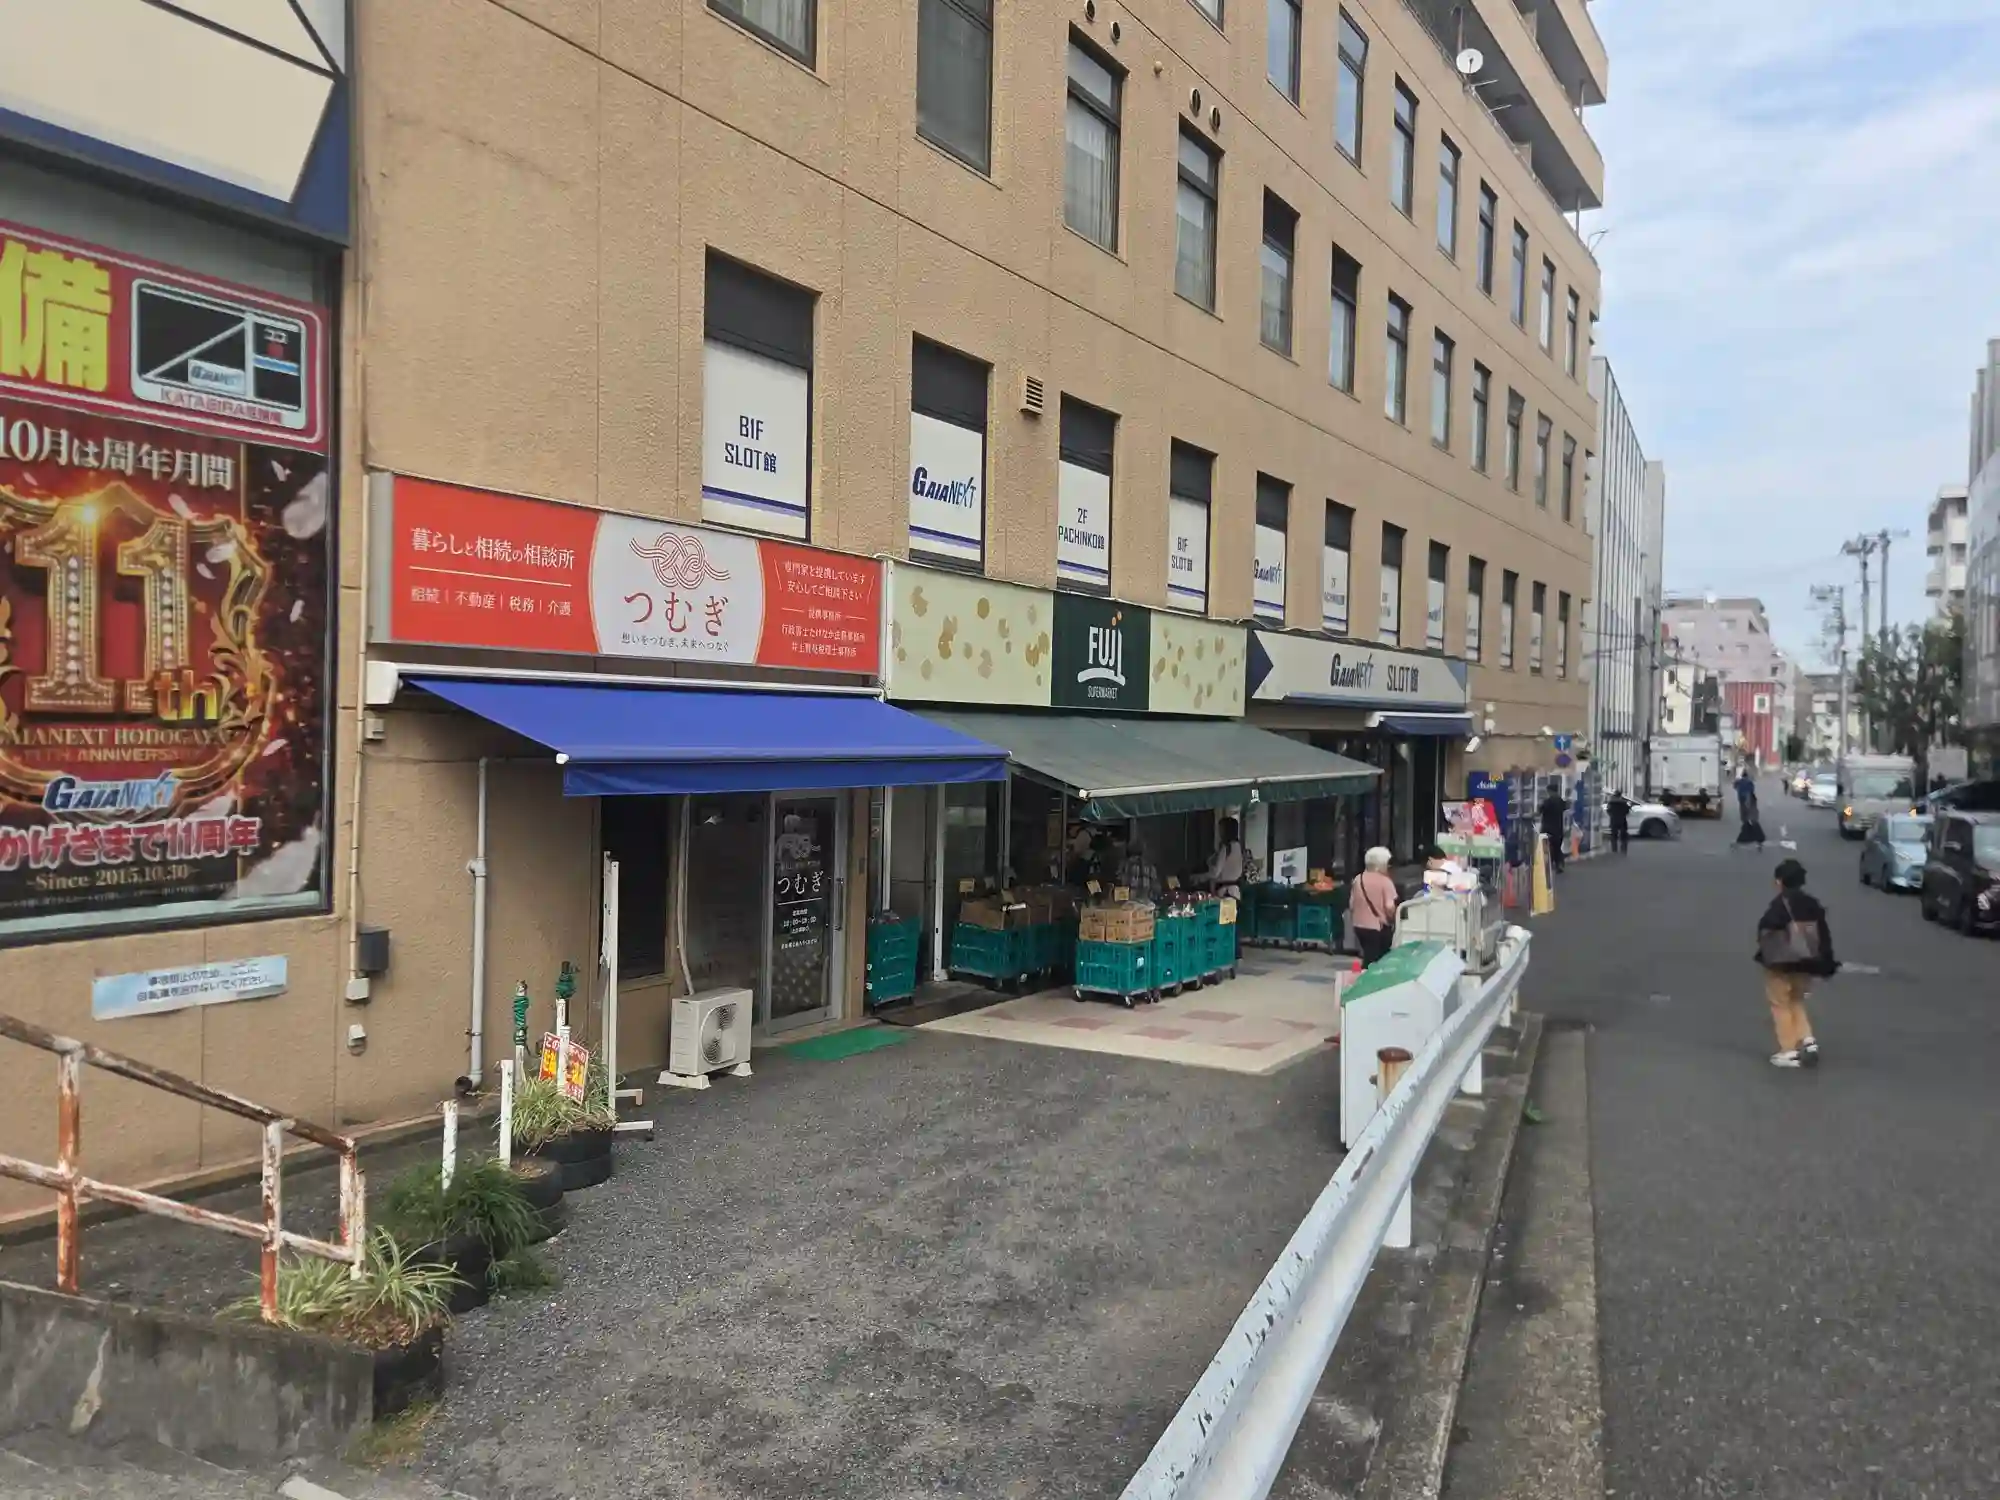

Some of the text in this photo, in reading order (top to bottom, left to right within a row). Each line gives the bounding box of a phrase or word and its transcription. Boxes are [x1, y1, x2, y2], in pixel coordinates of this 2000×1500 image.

[724, 442, 777, 473] SLOT館
[1077, 508, 1088, 524] 2F
[410, 527, 575, 570] 暮らしと相続の相談所
[455, 591, 496, 609] 不動産
[509, 596, 534, 613] 税務
[547, 600, 572, 617] 介護
[624, 591, 728, 636] つむぎ
[1084, 618, 1126, 686] FUJI
[777, 870, 824, 894] つむぎ
